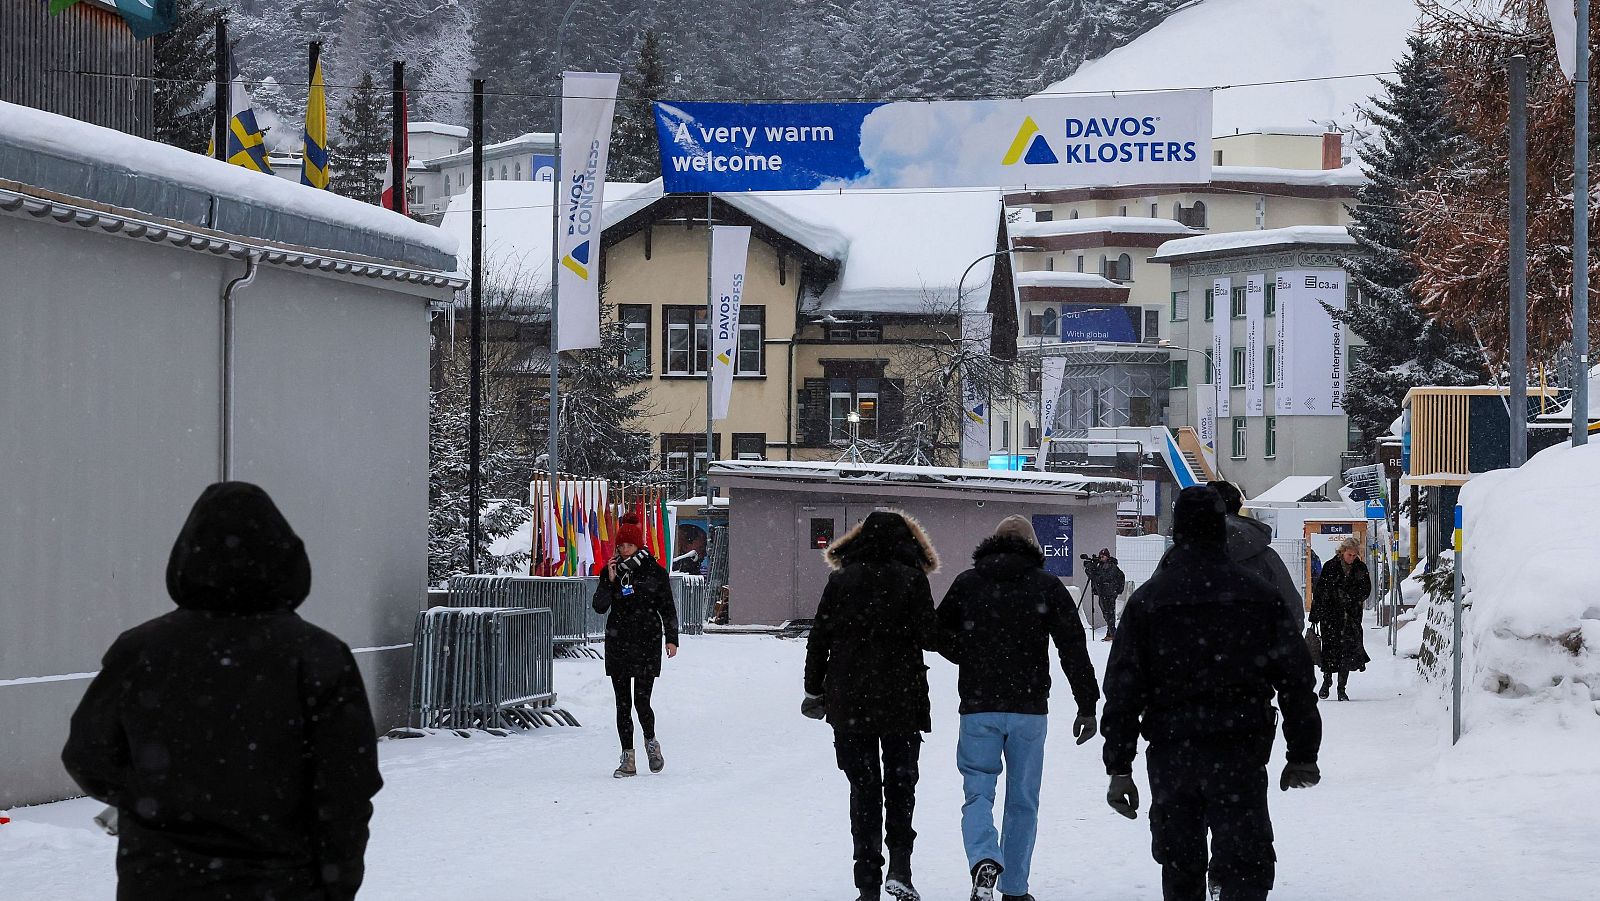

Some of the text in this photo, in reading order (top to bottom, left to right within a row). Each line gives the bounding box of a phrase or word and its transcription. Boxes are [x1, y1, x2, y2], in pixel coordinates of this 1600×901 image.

[674, 122, 834, 148] A very warm
[1066, 142, 1196, 164] KLOSTERS
[672, 151, 783, 172] welcome
[1318, 281, 1339, 290] C3.ai
[1086, 331, 1109, 339] global
[1331, 332, 1341, 379] Enterprise
[1332, 381, 1340, 389] is
[1332, 395, 1340, 410] This
[1044, 544, 1069, 557] Exit
